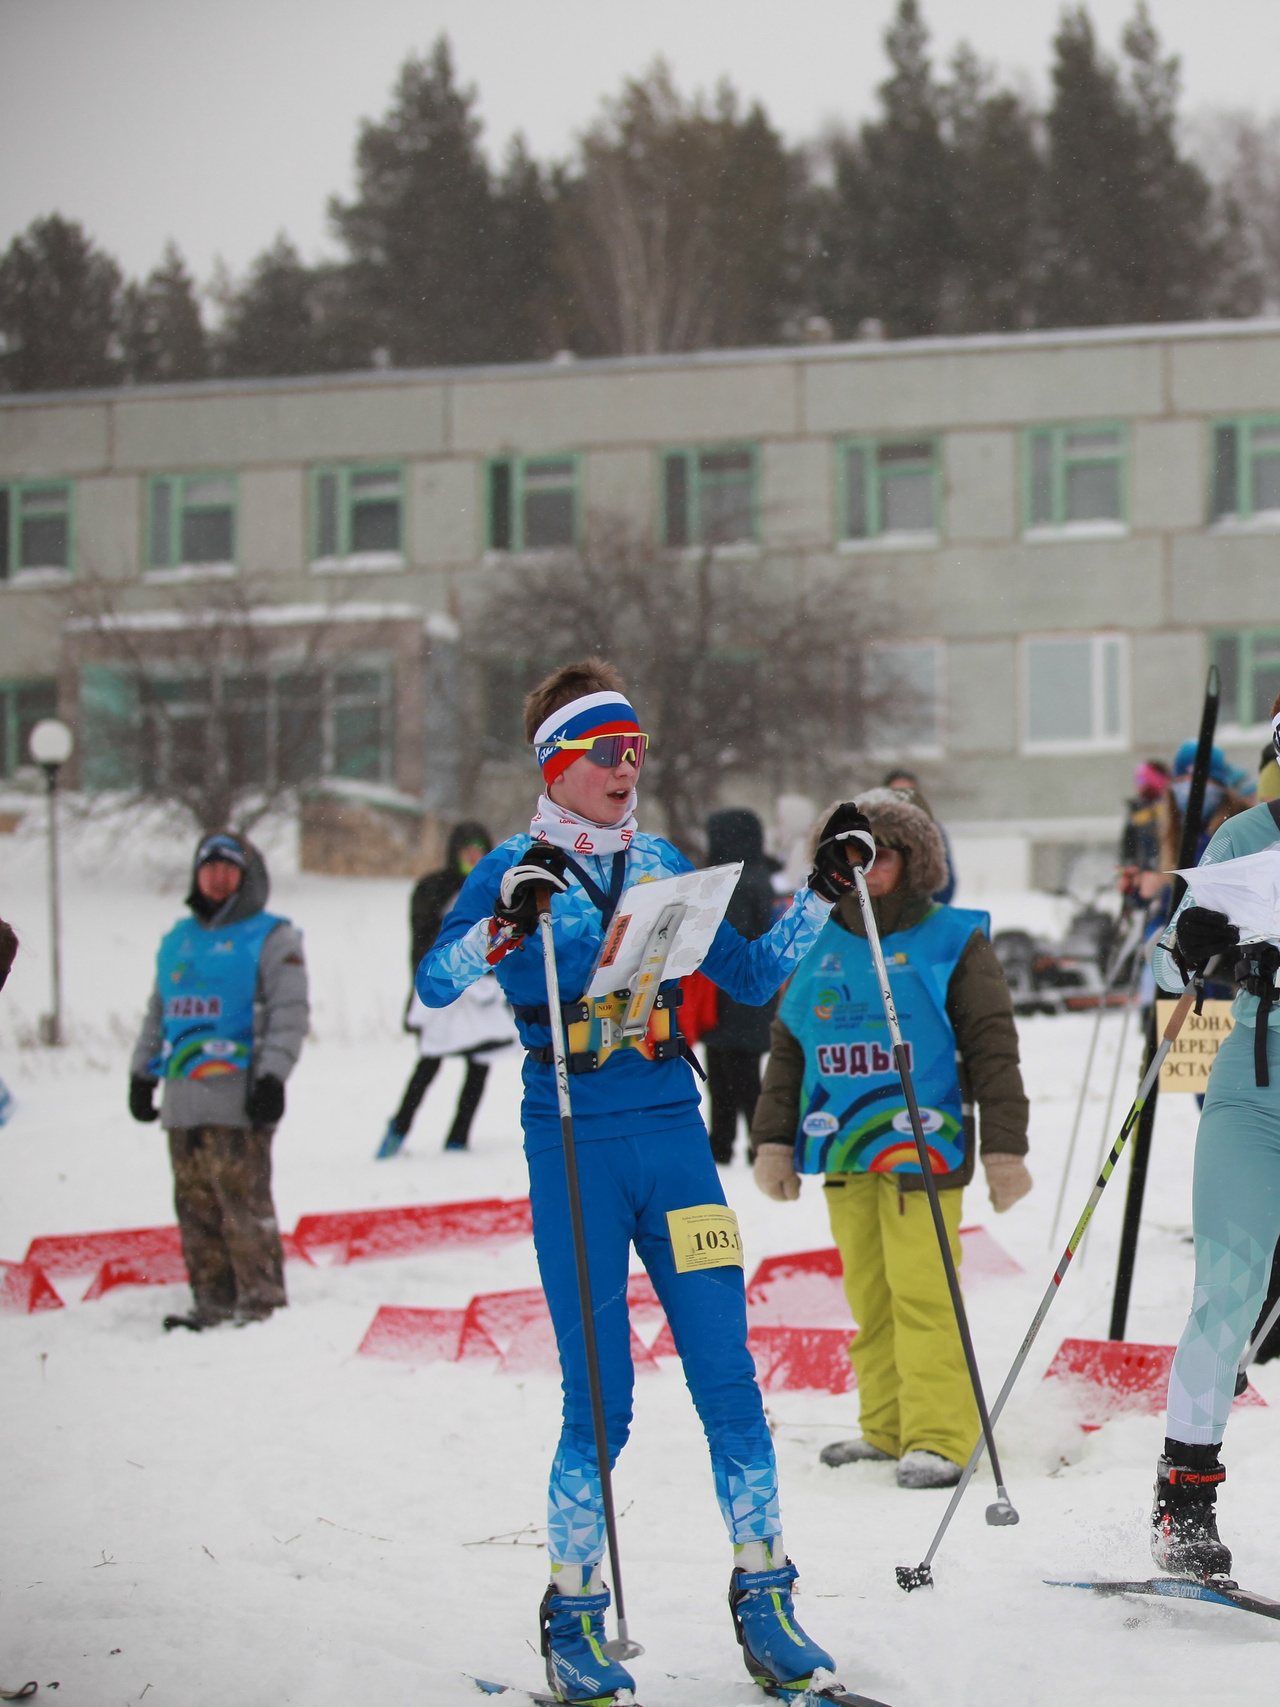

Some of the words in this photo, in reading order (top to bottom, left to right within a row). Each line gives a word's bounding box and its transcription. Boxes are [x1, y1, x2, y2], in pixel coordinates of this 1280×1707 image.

[1187, 1016, 1232, 1031] ЗОНА
[744, 1571, 791, 1585] SPINE
[560, 1597, 607, 1607] SPINE
[550, 1648, 602, 1693] SPINE
